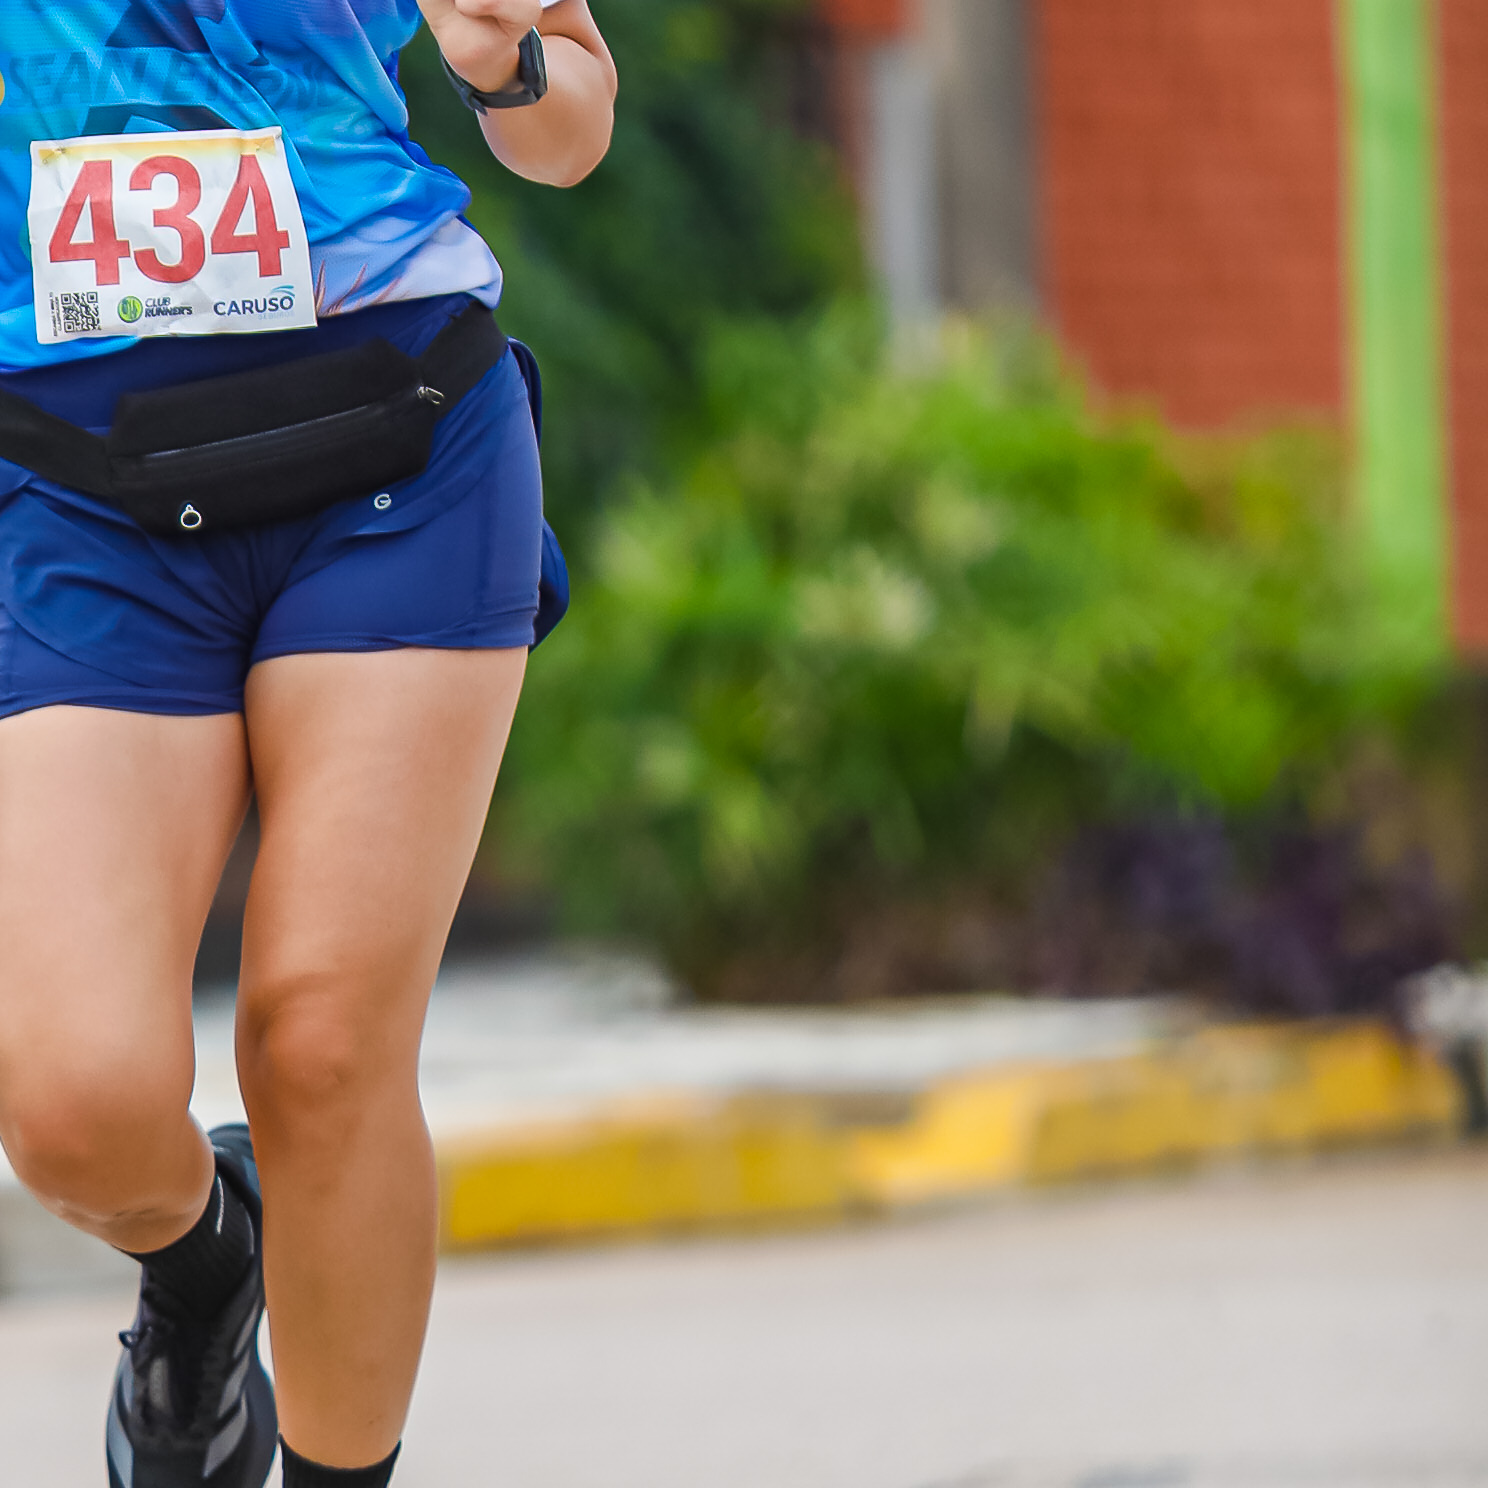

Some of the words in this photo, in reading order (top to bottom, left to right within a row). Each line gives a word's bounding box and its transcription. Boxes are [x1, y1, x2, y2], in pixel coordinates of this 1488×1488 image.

[48, 154, 290, 286] 434
[145, 297, 171, 307] CLUB
[213, 296, 294, 316] CARUSO
